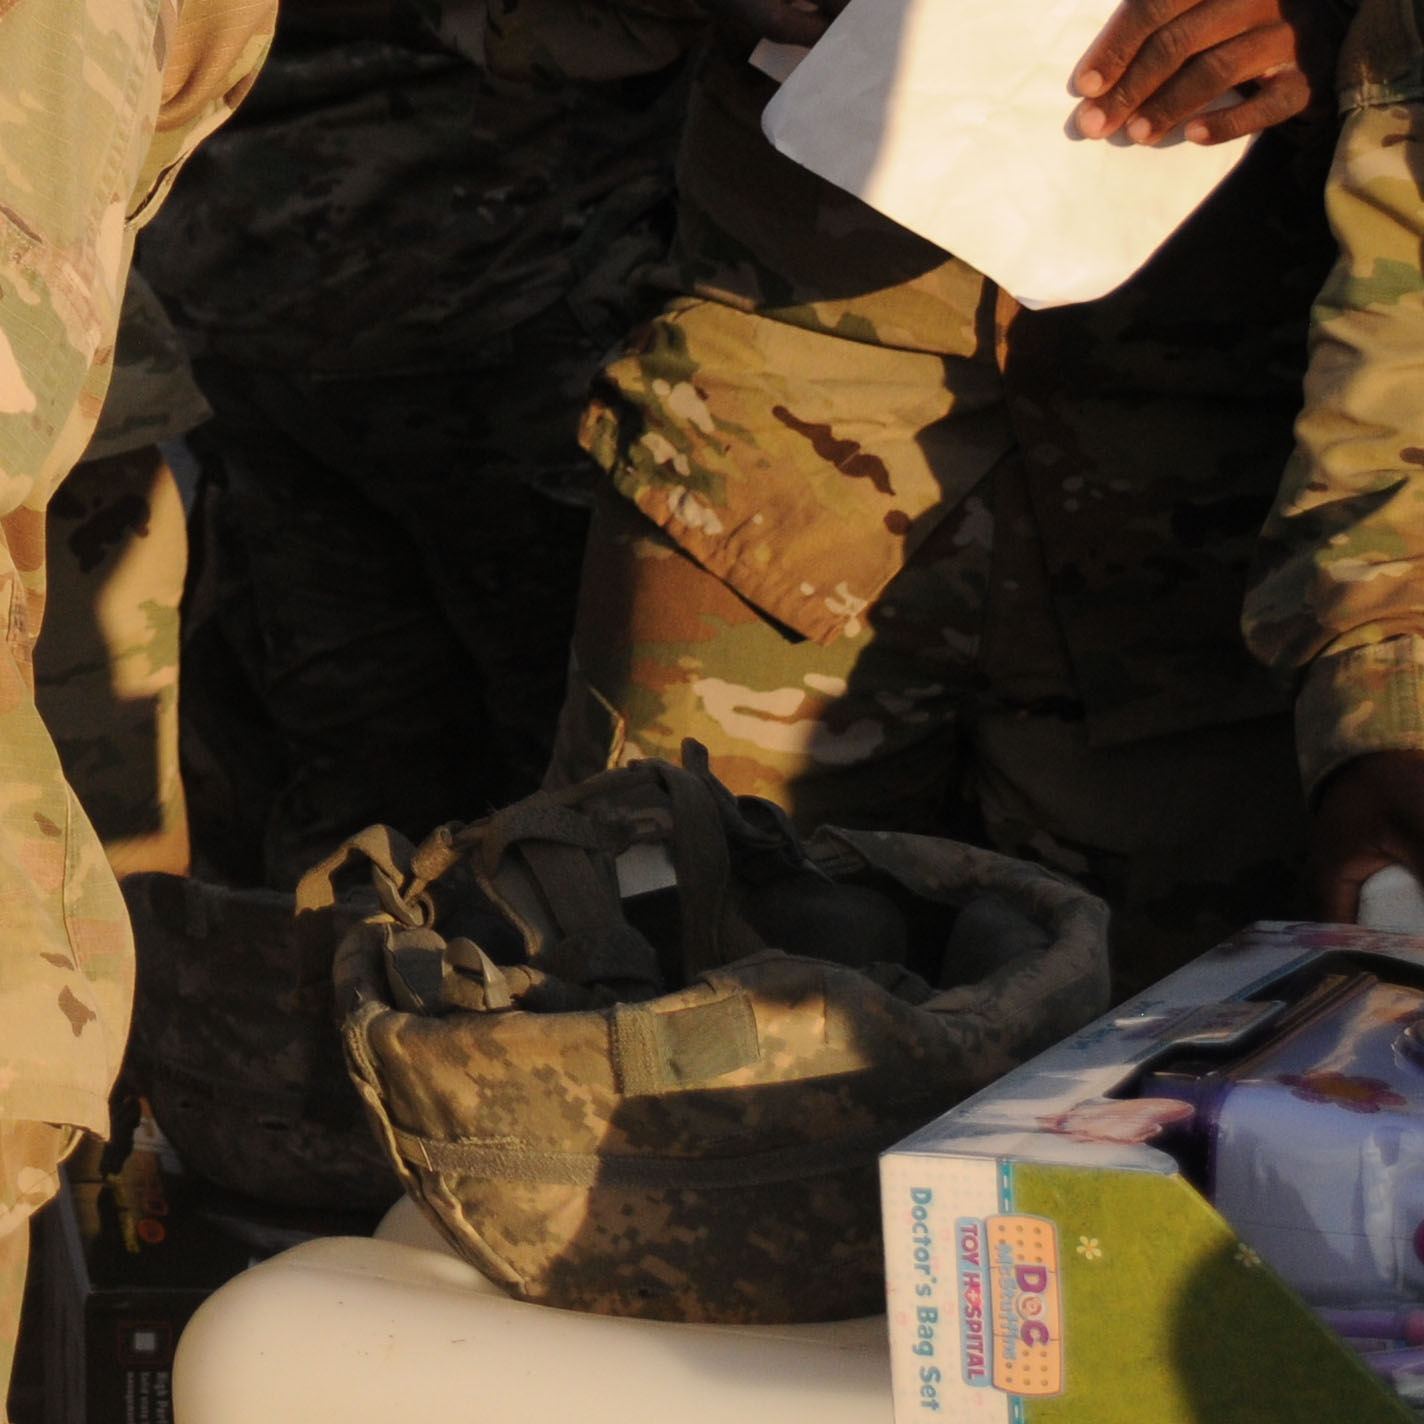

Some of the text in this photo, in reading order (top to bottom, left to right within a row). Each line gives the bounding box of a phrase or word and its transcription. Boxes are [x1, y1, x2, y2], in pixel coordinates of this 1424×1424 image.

[910, 1187, 941, 1411] Doctor's Bag Set
[960, 1224, 986, 1380] TOY HOSPITAL
[1014, 1263, 1050, 1347] DOC
